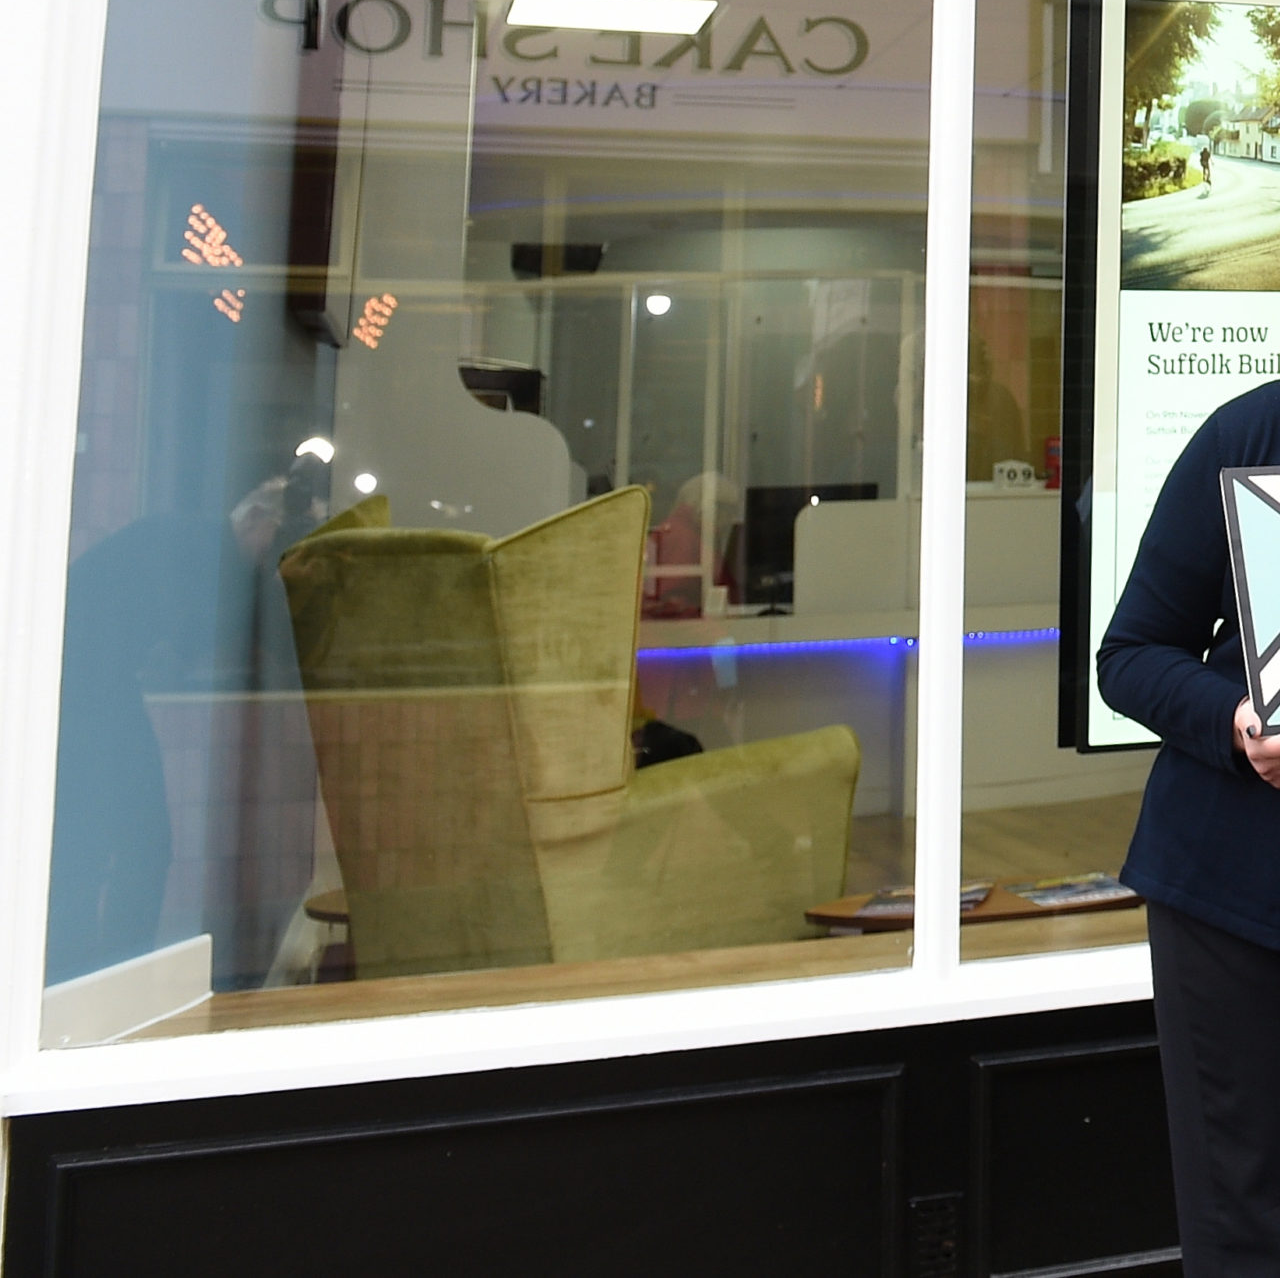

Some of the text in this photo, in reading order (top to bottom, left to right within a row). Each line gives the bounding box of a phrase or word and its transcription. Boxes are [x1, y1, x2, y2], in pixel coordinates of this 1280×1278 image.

[1147, 322, 1269, 343] We're now
[1147, 353, 1232, 375] Suffolk
